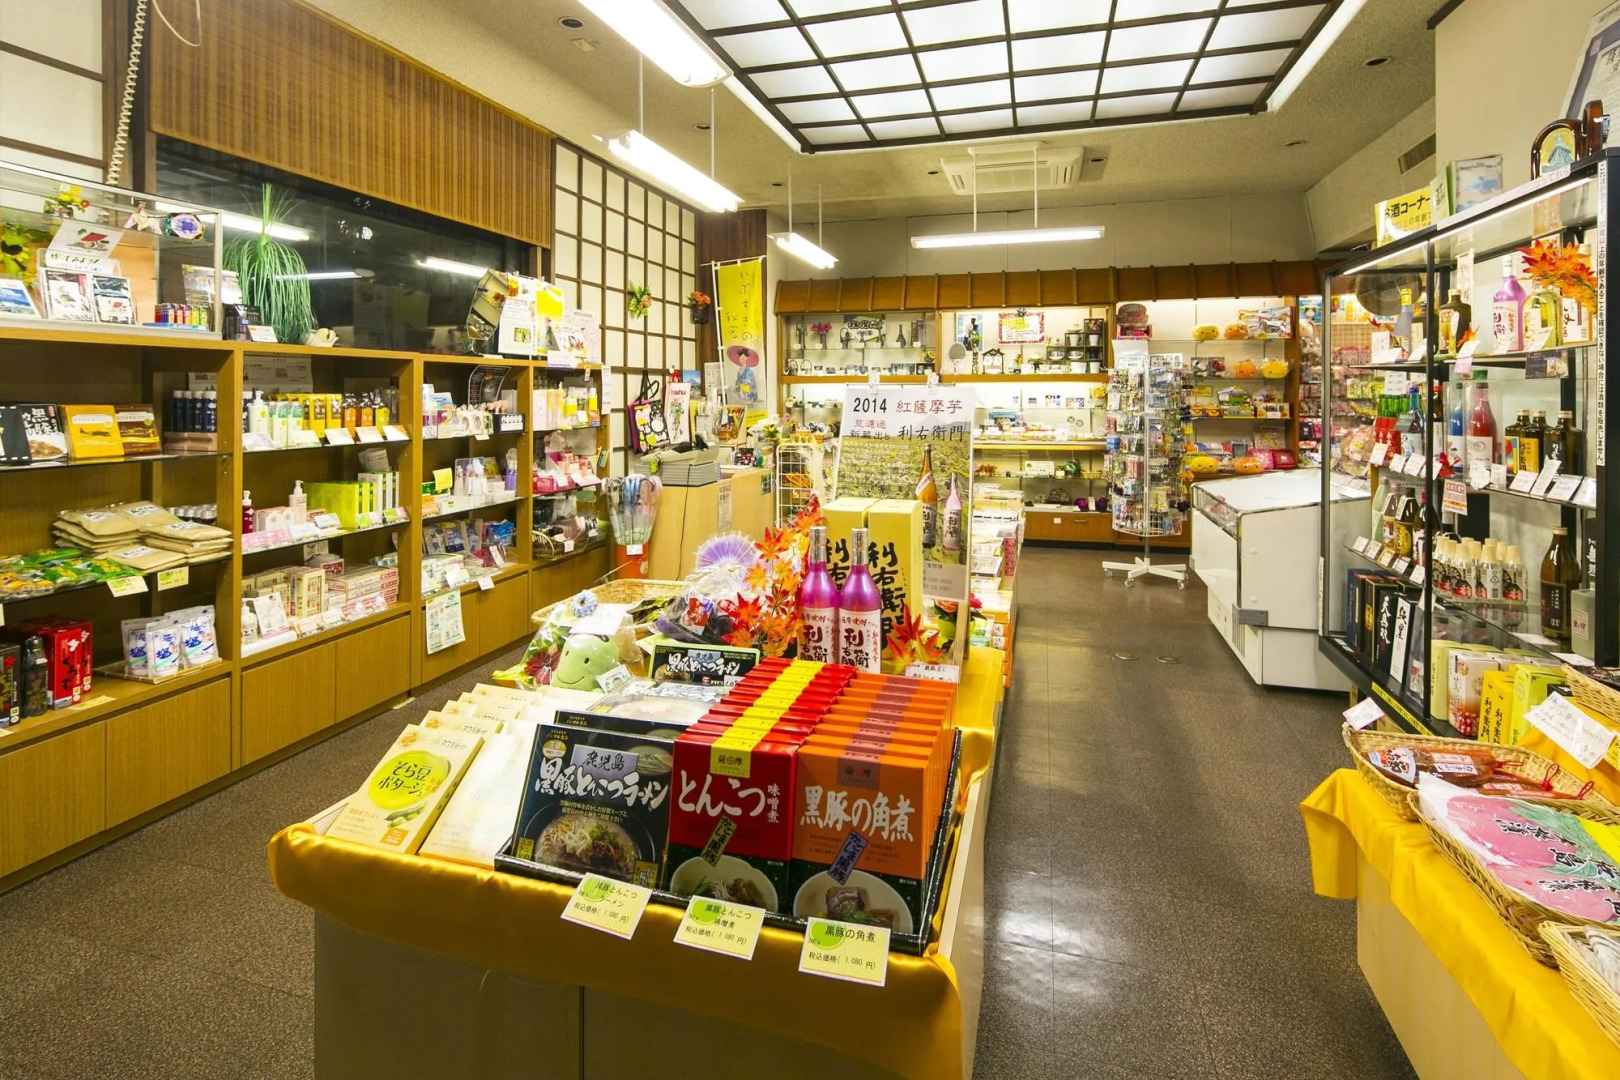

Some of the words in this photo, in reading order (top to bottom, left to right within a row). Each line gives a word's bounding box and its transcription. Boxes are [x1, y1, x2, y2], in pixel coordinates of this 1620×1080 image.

[739, 271, 753, 341] いぶすきの
[853, 397, 887, 414] 2014
[896, 399, 963, 415] 紅薩摩芋
[898, 424, 963, 442] 利右衛門
[666, 652, 741, 676] 黒豚とんこつラーメン
[392, 760, 434, 782] そら豆
[583, 750, 626, 771] 鹿児島
[377, 774, 424, 797] ポタージュ
[534, 758, 669, 809] 黒豚とんこつラーメン
[677, 769, 766, 817] とんこつ
[766, 783, 781, 824] 味噌煮
[800, 785, 916, 842] 黒豚の角煮
[595, 880, 638, 899] 黒豚とんこつ
[704, 902, 752, 920] 黒豚とんこつ
[714, 917, 736, 929] 味噌煮
[825, 925, 876, 943] 黒豚の角煮
